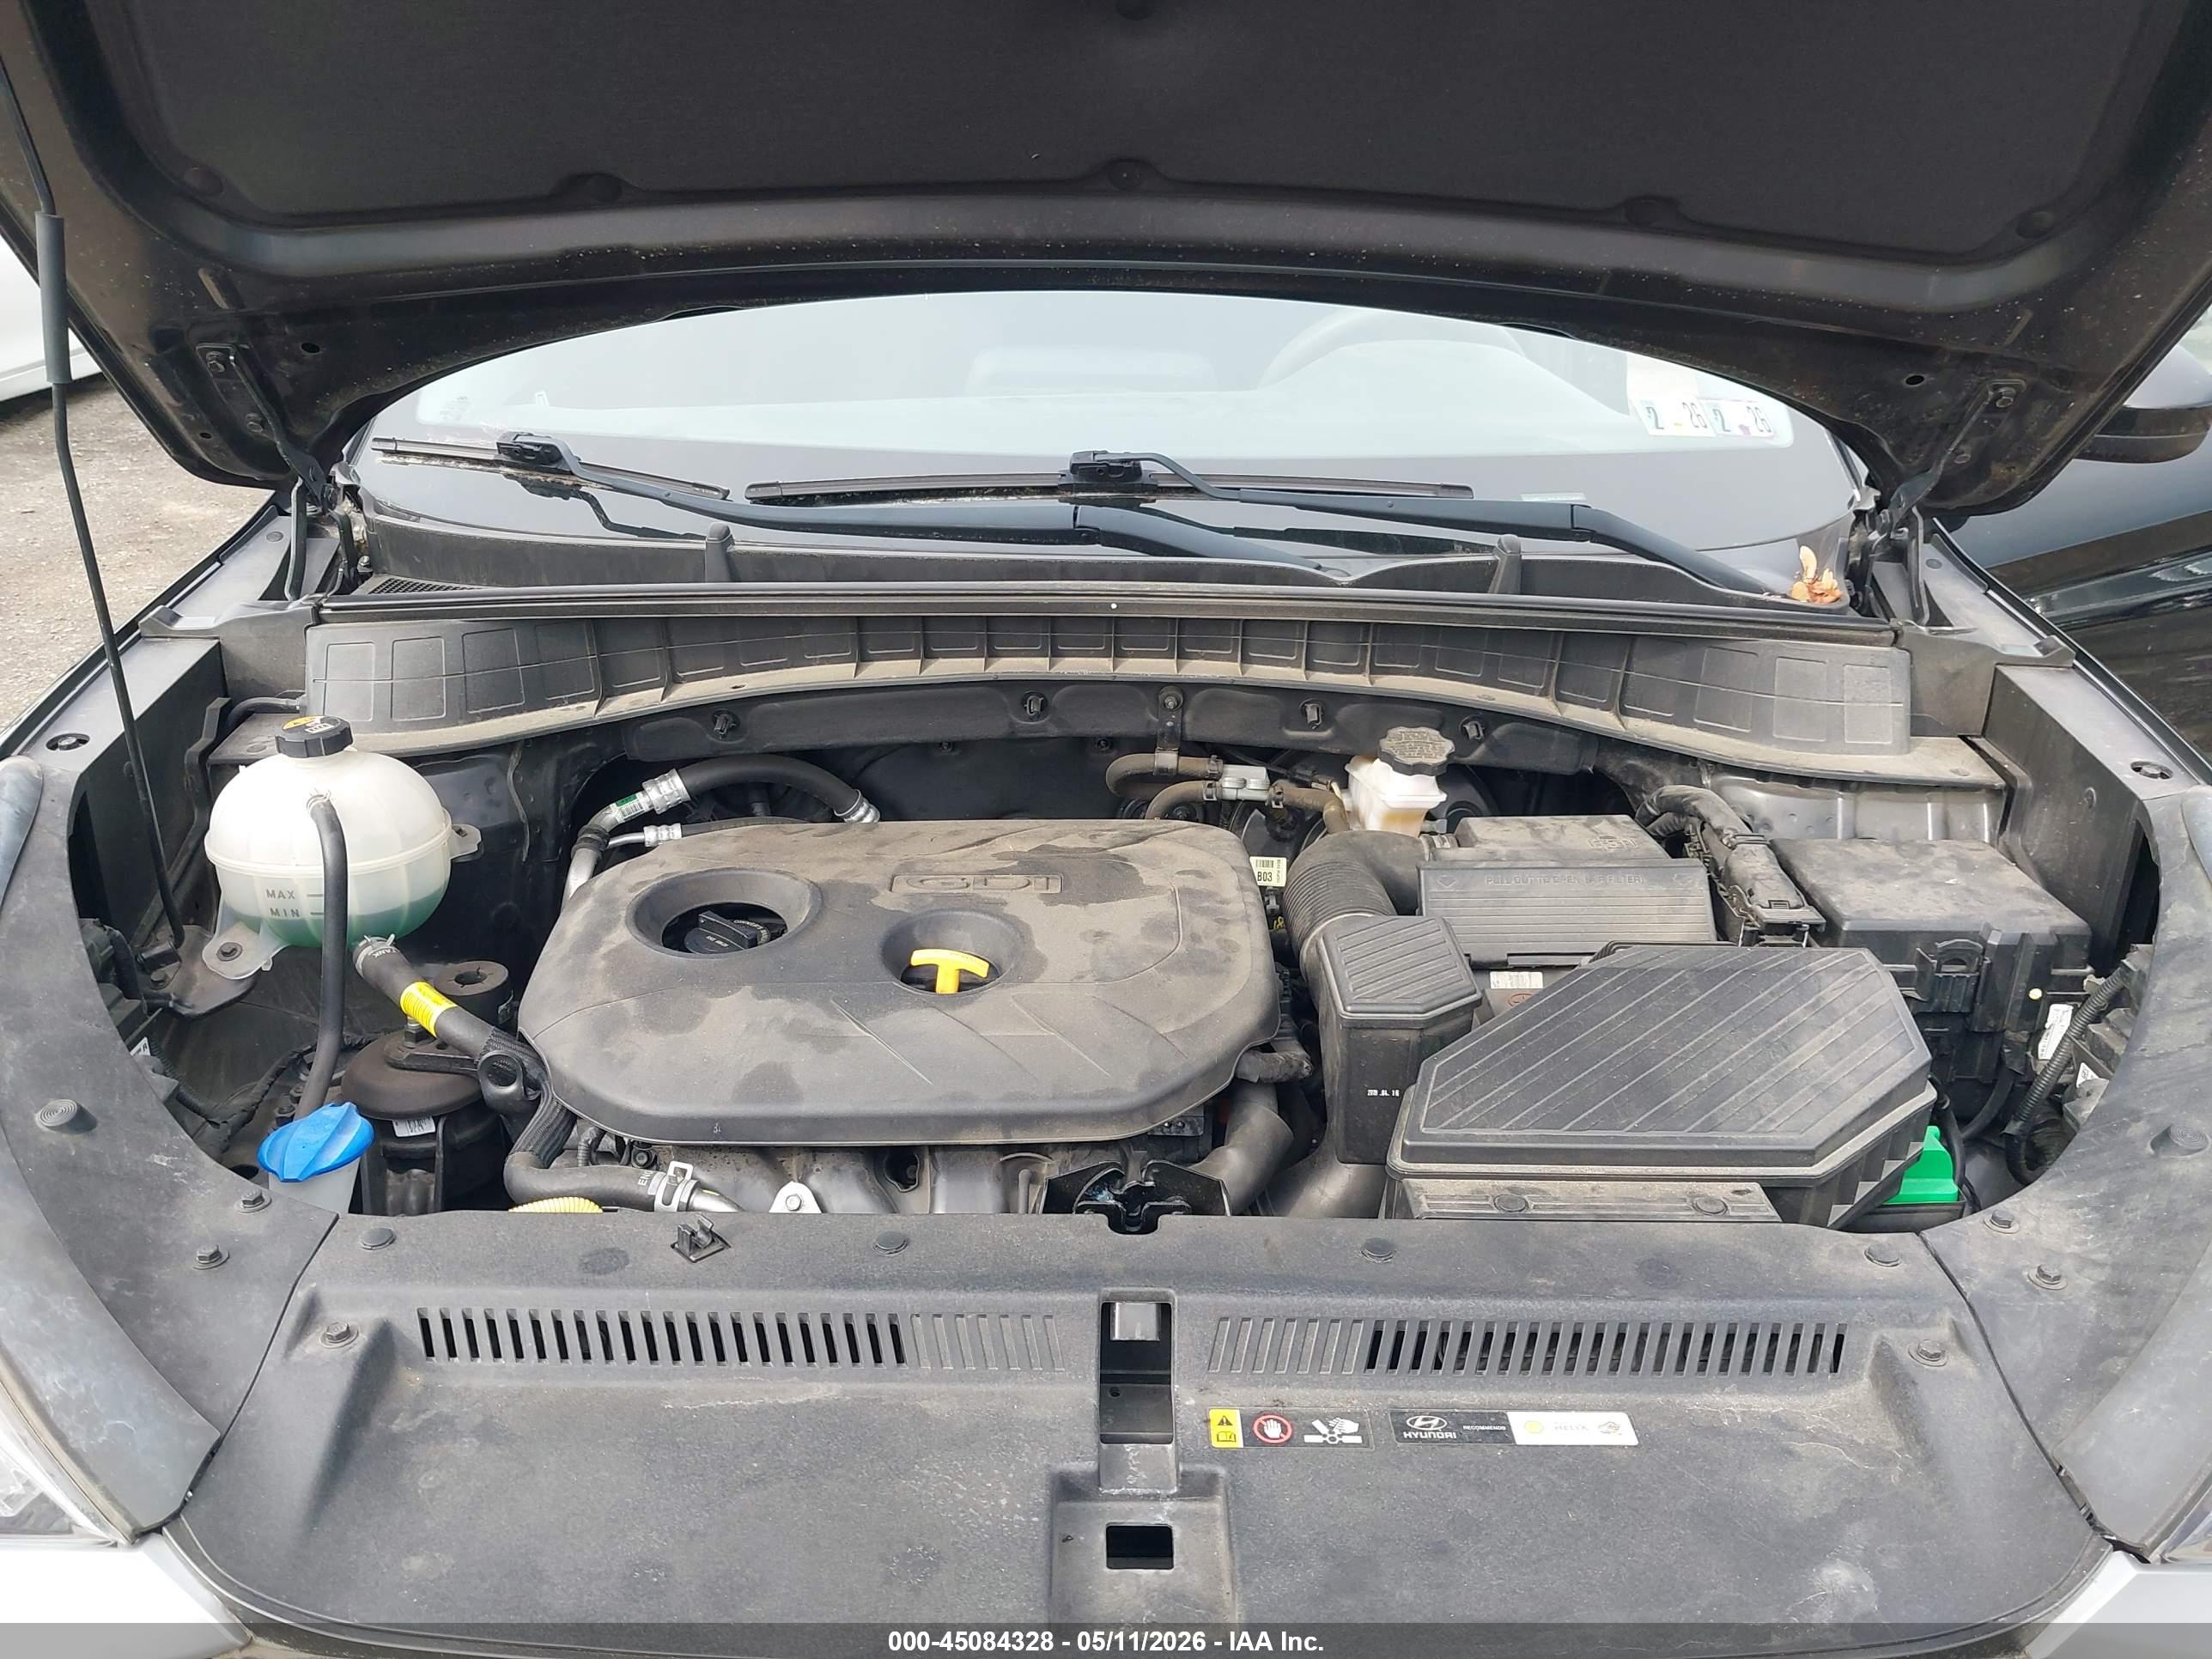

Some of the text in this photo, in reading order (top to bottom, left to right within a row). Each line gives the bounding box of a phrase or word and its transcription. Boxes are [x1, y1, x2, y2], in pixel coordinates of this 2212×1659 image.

[1645, 406, 1665, 430] 2
[1711, 408, 1731, 433] 2
[1257, 872, 1273, 882] B03
[265, 889, 295, 900] MAX
[270, 907, 300, 918] MIN
